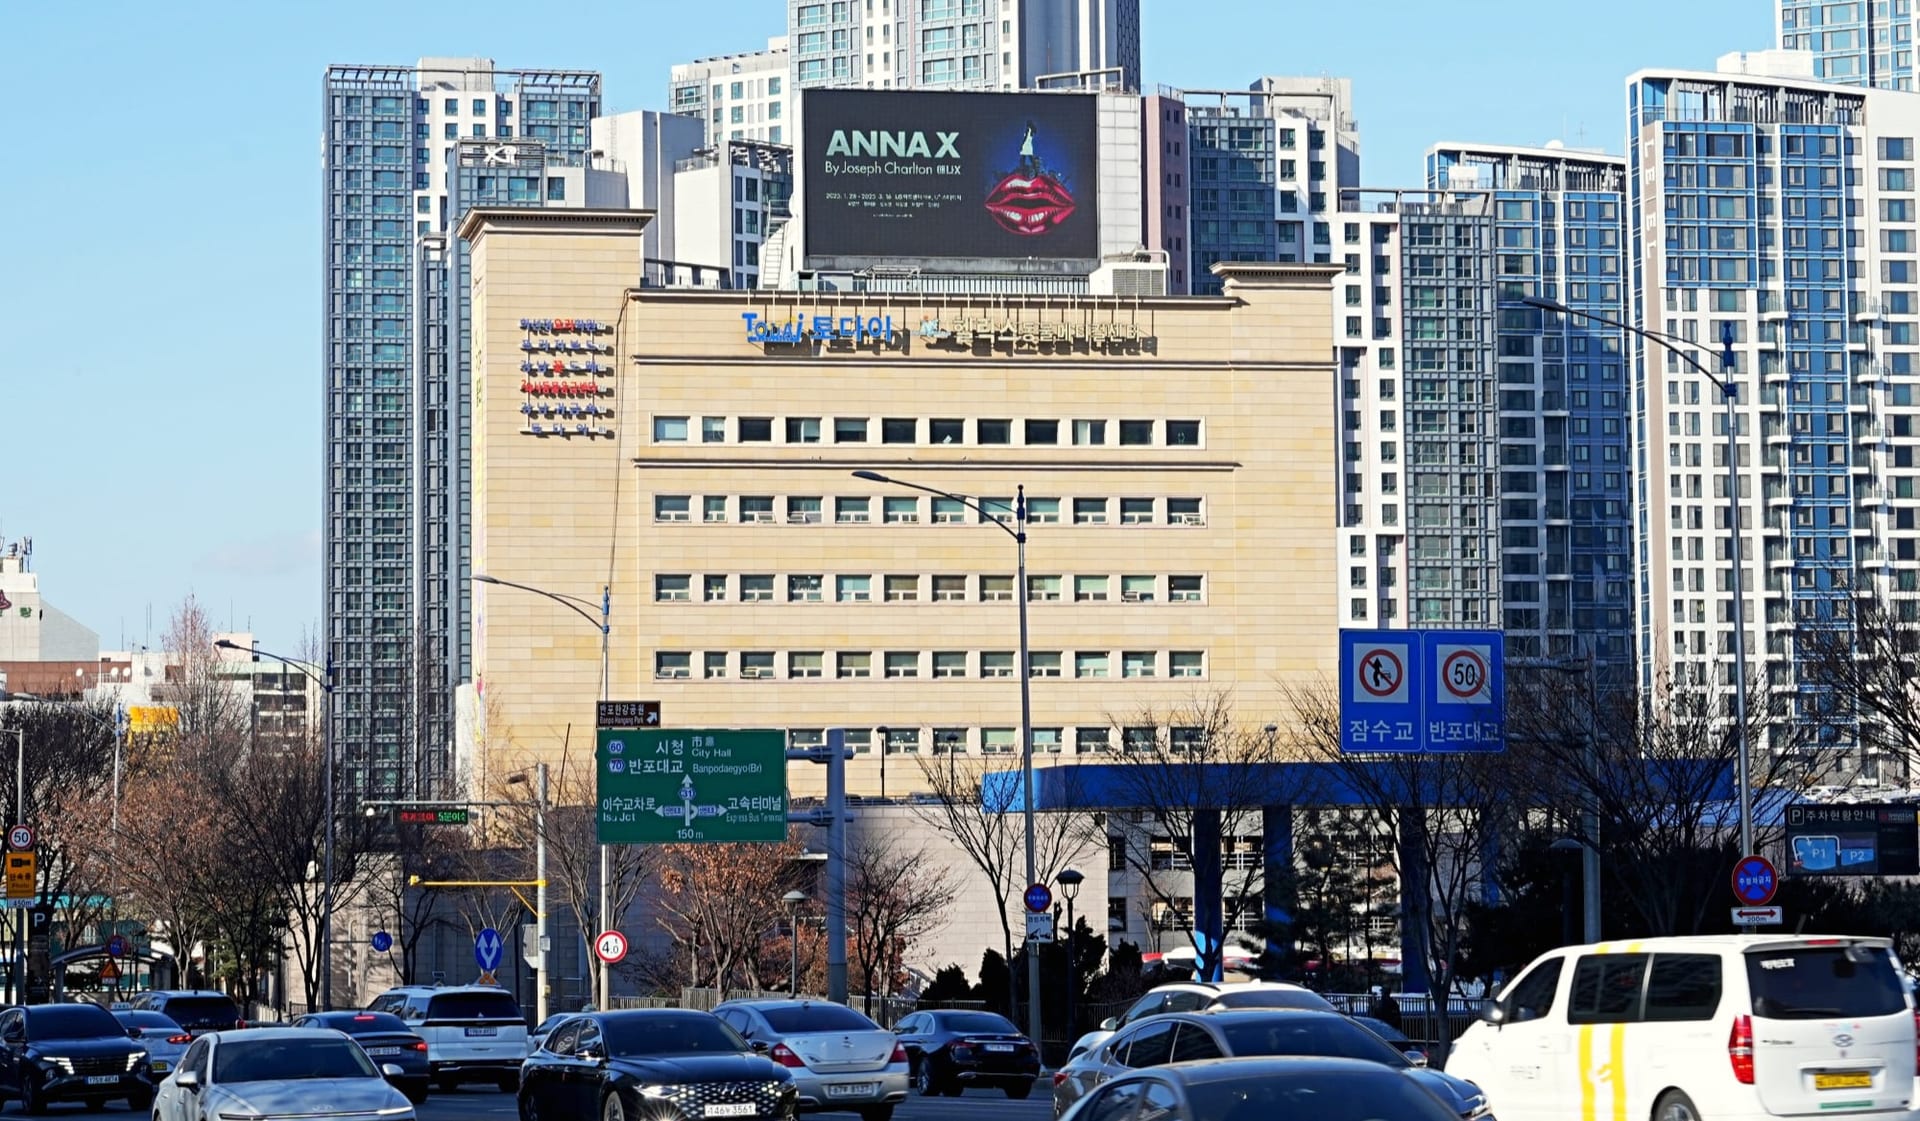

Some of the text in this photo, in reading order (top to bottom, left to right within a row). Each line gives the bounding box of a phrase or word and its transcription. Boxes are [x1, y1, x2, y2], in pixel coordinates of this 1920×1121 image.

[826, 130, 961, 159] ANNA X
[825, 160, 840, 176] By
[841, 160, 882, 177] Joseph
[884, 161, 933, 175] Charlton
[810, 314, 892, 342] 토다이
[1454, 663, 1475, 687] 50
[600, 704, 644, 716] 반포한강공원
[1350, 720, 1414, 743] 잠수교
[1429, 720, 1500, 744] 반포대교
[655, 739, 684, 756] 시청
[691, 747, 732, 760] City Hall
[629, 758, 684, 775] 반포대교
[602, 796, 656, 812] 이수교차로
[727, 795, 782, 812] 고속터미널
[1806, 809, 1876, 822] 주차현황안내
[13, 831, 29, 844] 50
[676, 828, 694, 839] 150
[1812, 848, 1827, 859] P1
[1850, 850, 1865, 861] P2
[33, 912, 46, 928] P
